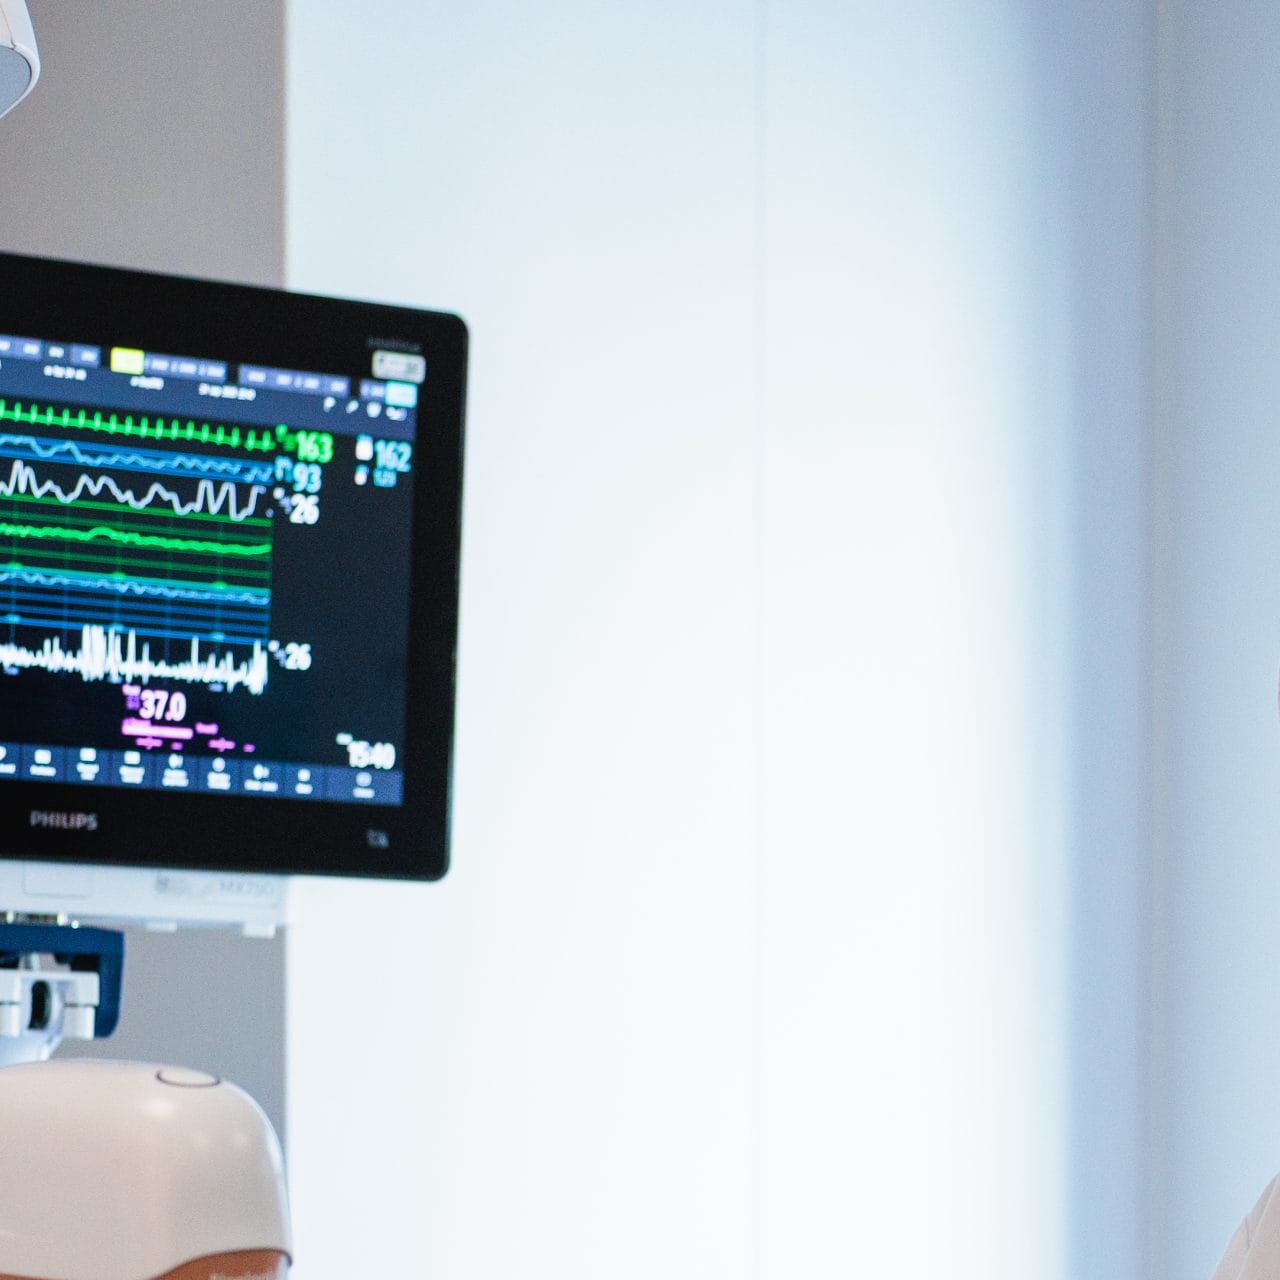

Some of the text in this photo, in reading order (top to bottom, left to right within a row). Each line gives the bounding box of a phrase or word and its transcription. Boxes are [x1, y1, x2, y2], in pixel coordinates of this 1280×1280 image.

[296, 430, 334, 463] 163
[374, 439, 412, 472] 162
[293, 461, 322, 493] 93
[289, 493, 320, 525] 26
[285, 643, 312, 670] 26
[139, 689, 186, 722] 37.0
[30, 809, 98, 831] PHILIPS
